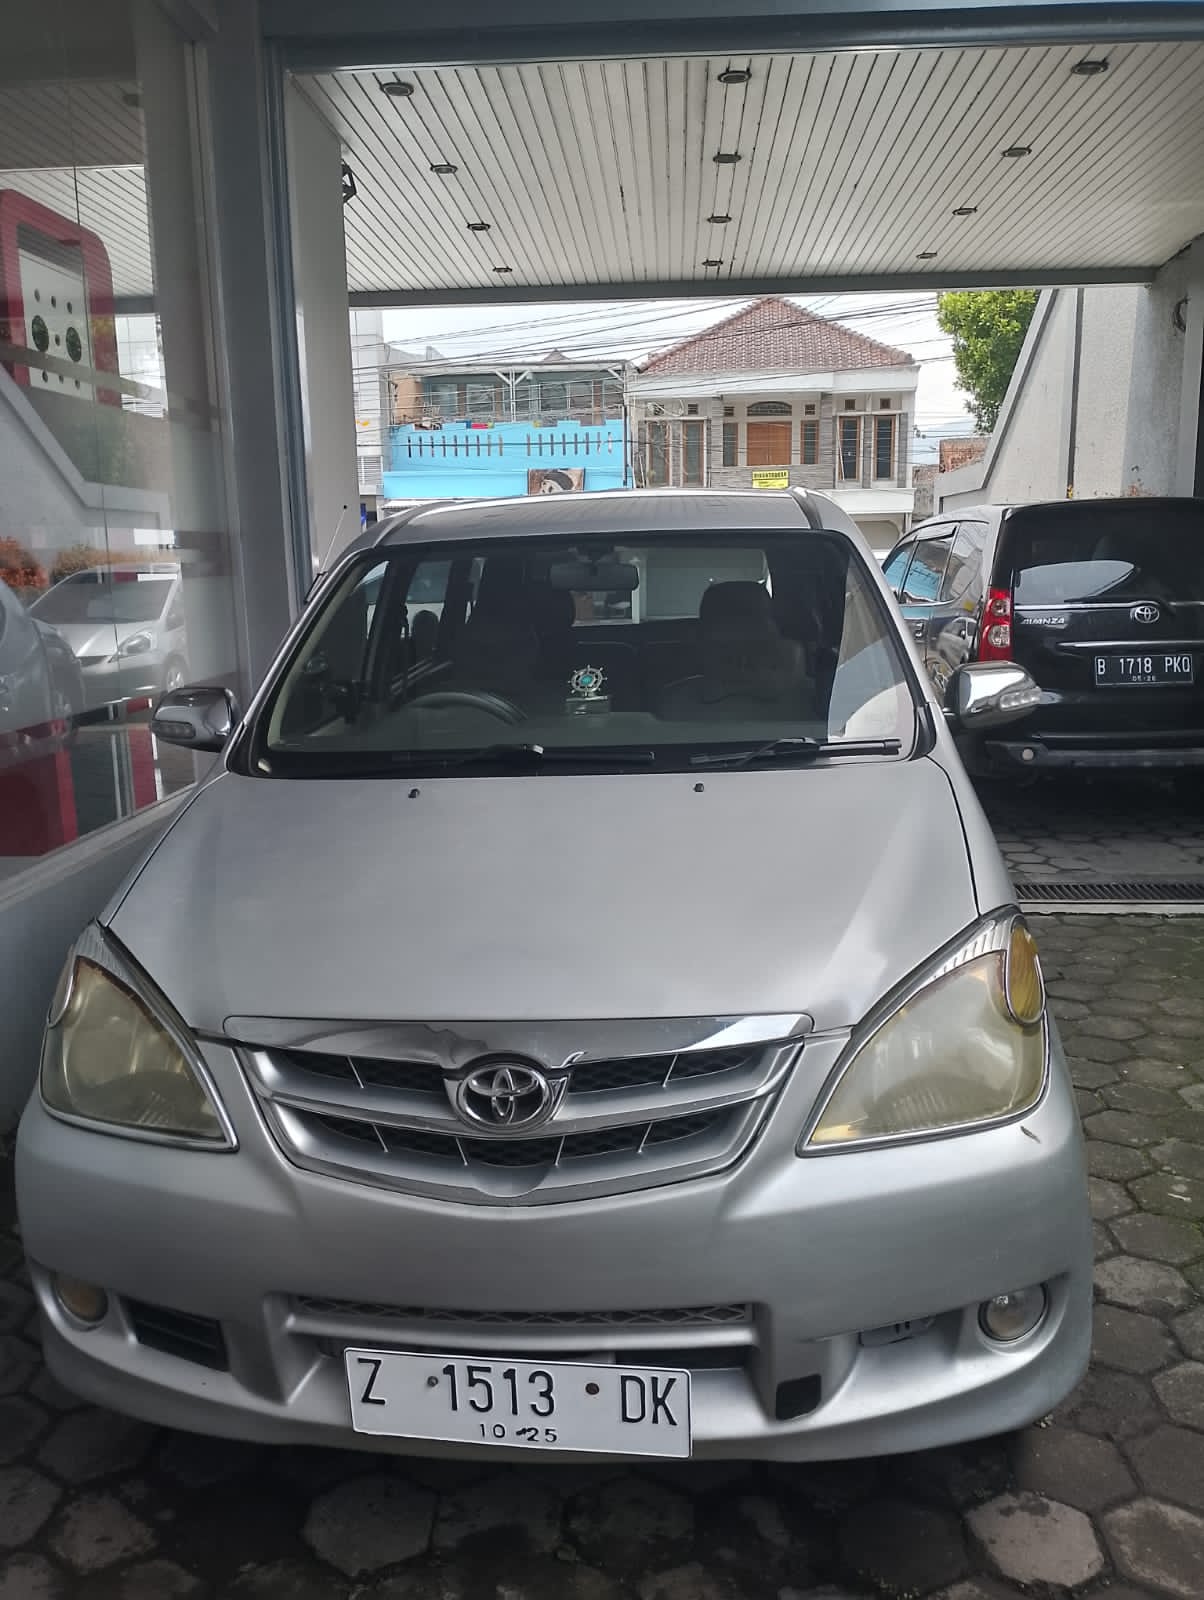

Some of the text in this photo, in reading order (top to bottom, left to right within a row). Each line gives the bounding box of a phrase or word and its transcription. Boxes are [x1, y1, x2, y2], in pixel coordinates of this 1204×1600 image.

[1097, 658, 1106, 675] B
[1119, 657, 1153, 675] 1718
[357, 1357, 678, 1426] Z 1513 DK
